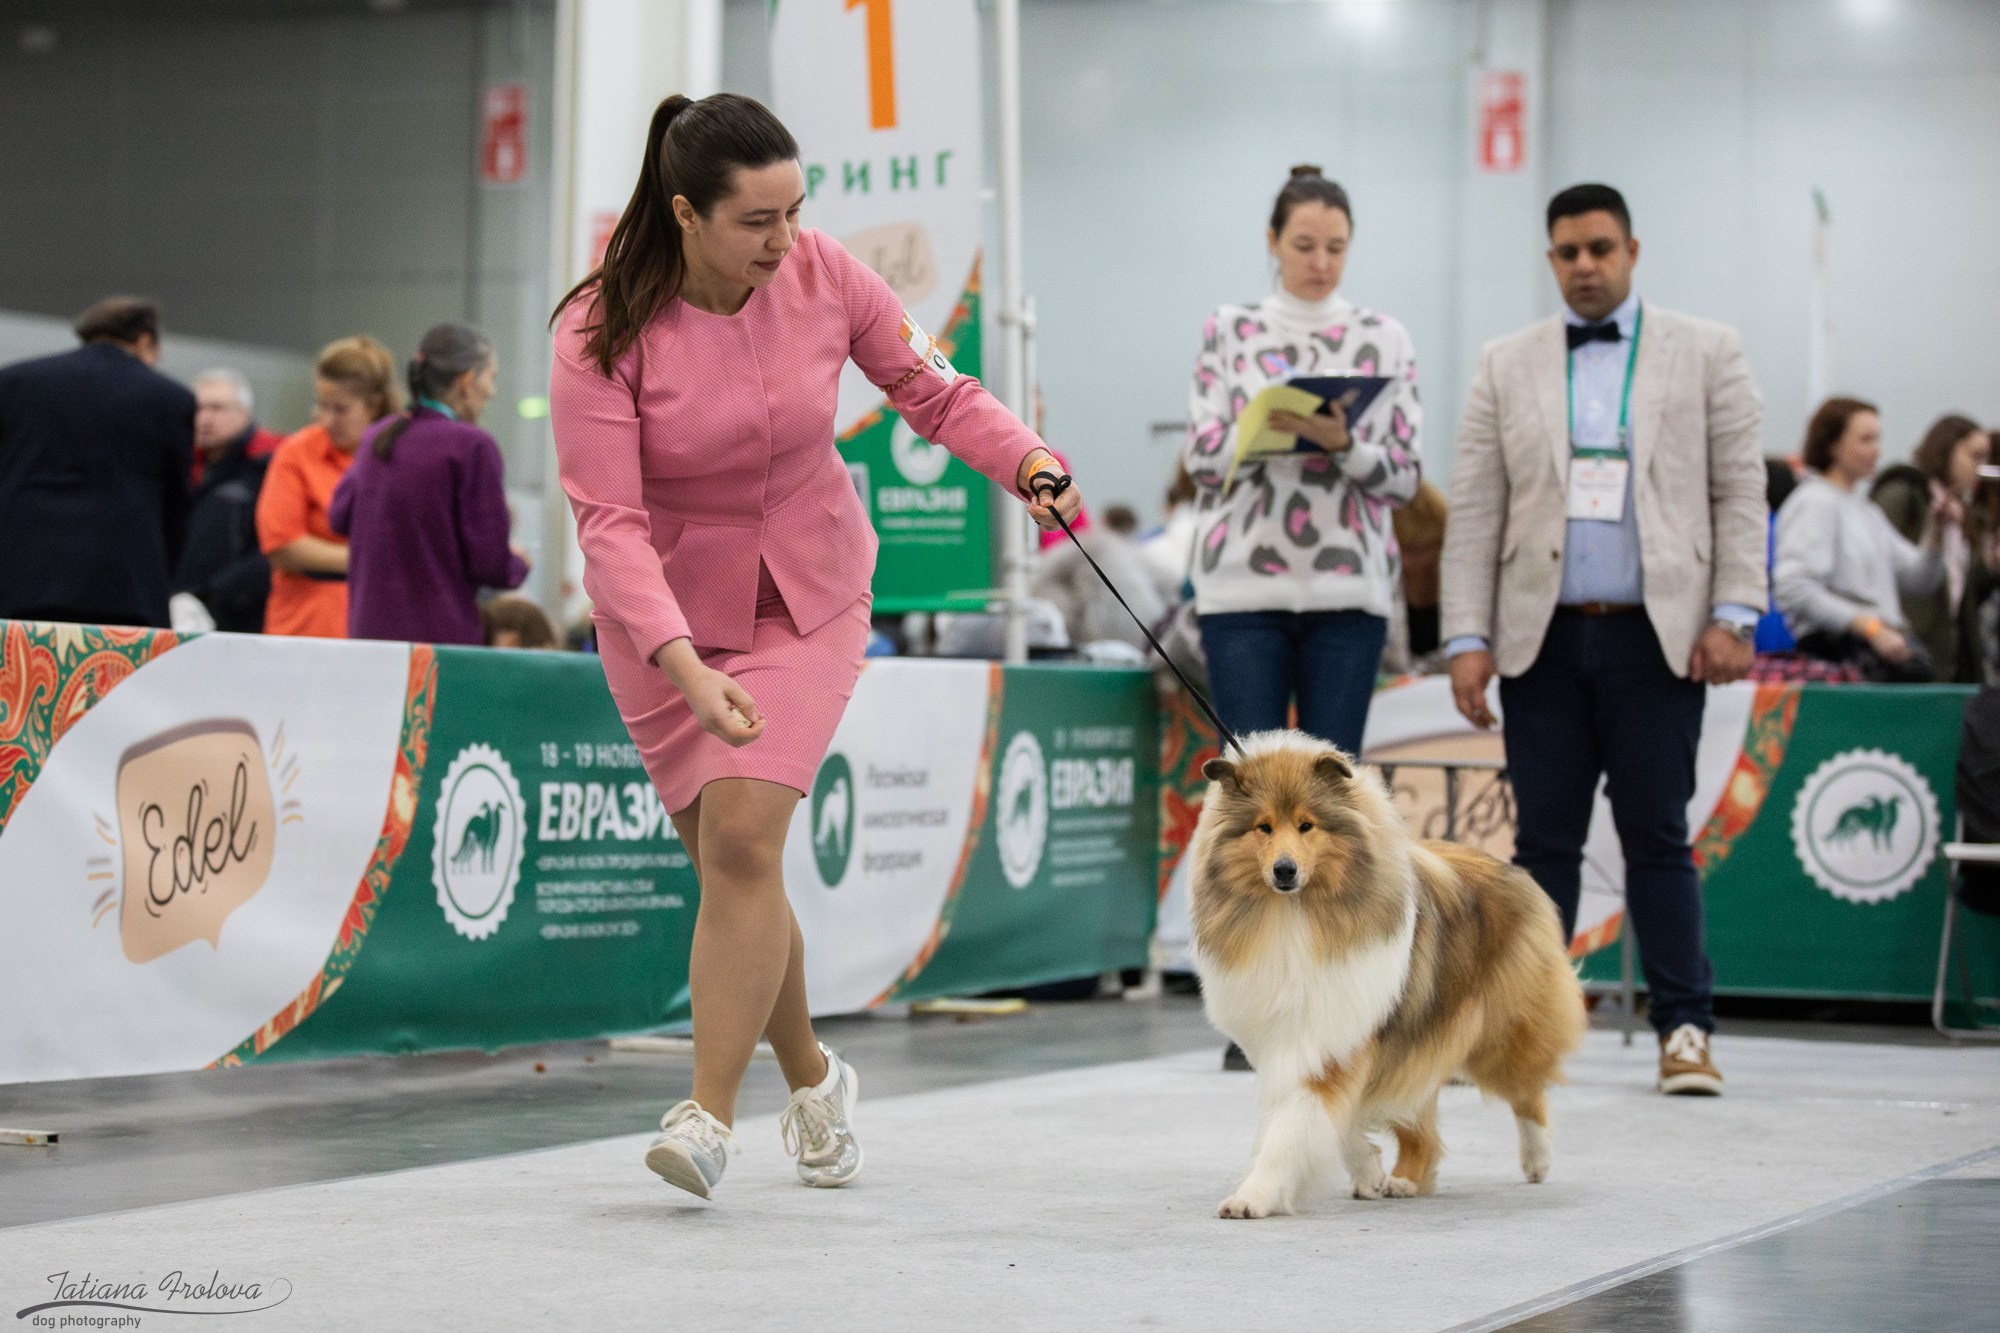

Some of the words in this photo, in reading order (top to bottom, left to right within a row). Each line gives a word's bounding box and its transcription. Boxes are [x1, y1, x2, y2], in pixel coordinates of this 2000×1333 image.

[844, 0, 897, 130] 1
[805, 150, 954, 199] РИНГ
[142, 761, 257, 907] Edel
[538, 781, 681, 842] ЕВРАЗИ
